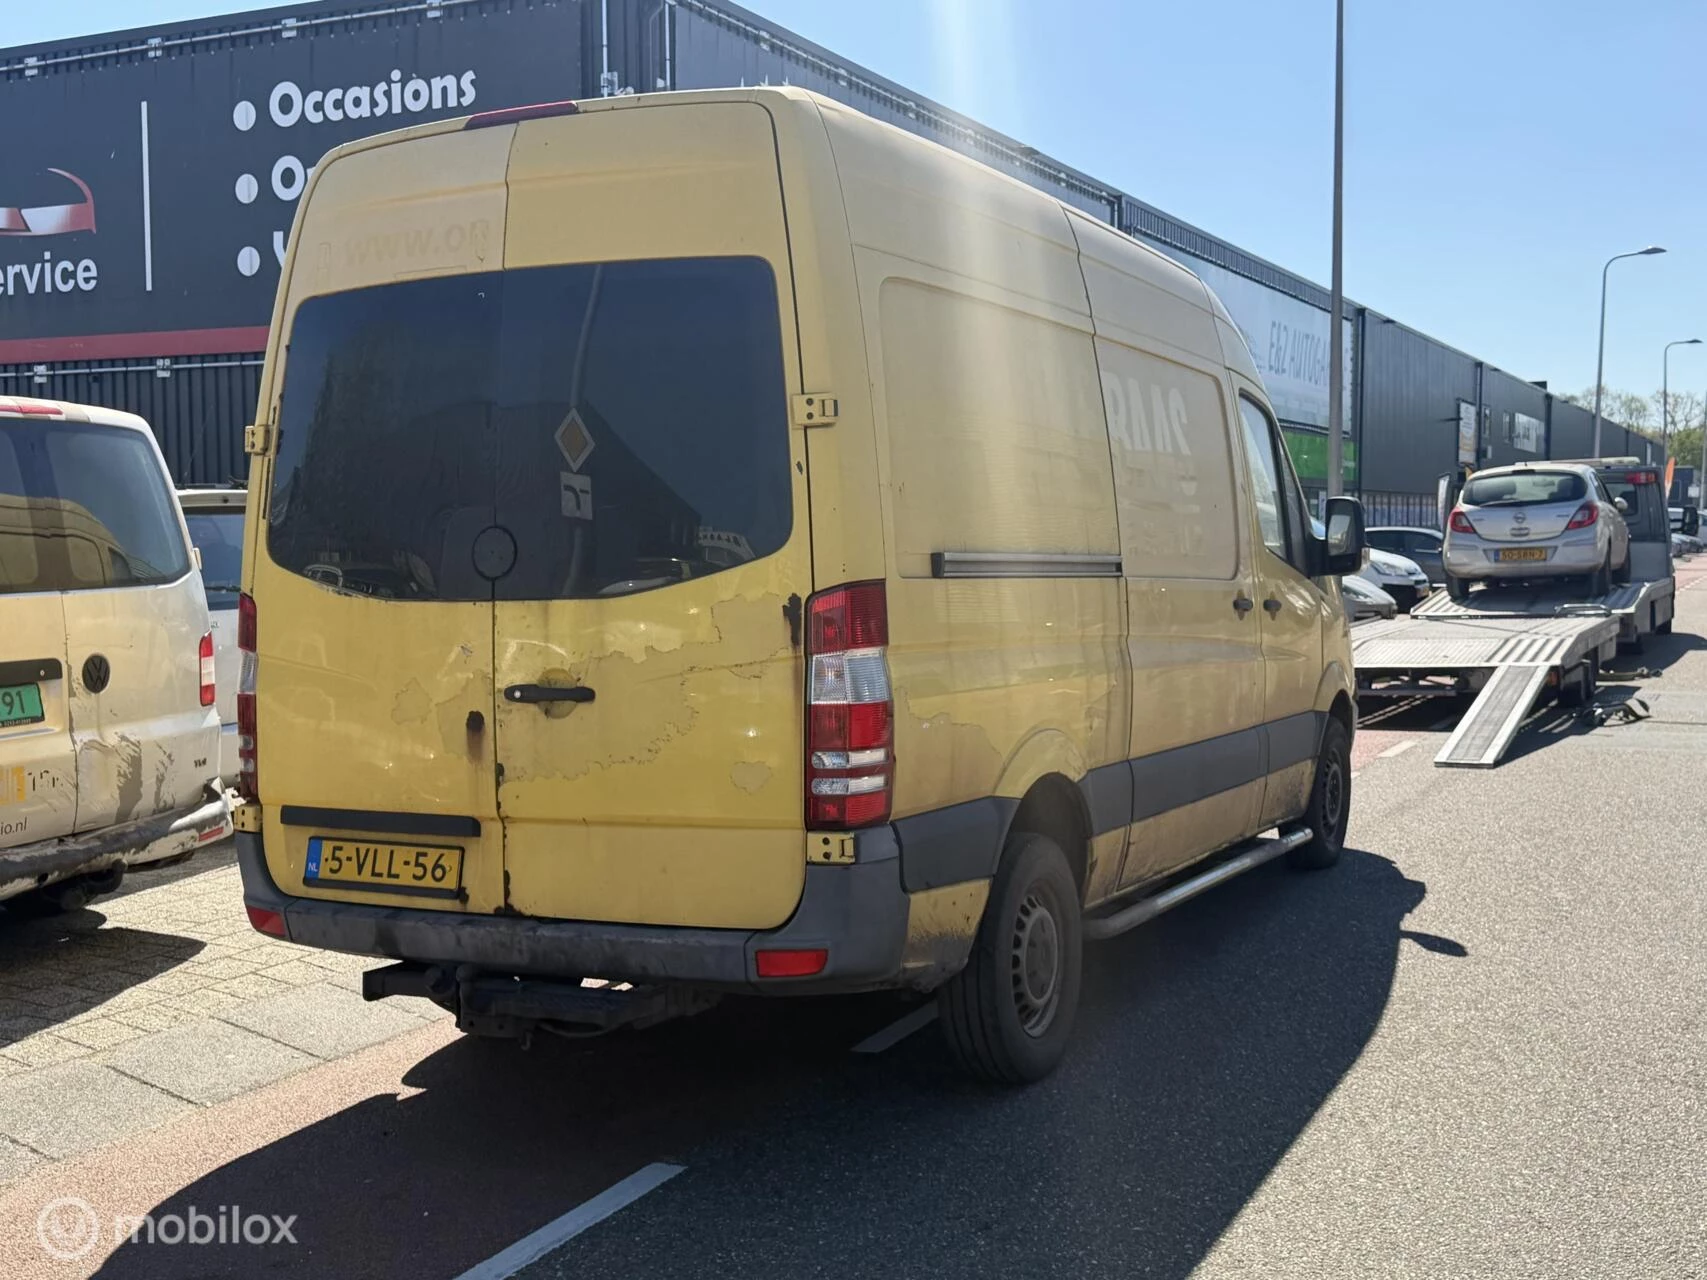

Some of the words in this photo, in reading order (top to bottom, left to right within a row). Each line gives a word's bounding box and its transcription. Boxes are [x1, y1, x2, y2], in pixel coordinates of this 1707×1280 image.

[269, 69, 476, 128] Occasions
[0, 251, 98, 296] rvice
[308, 862, 319, 872] NL
[328, 845, 447, 882] 5-VLL-56
